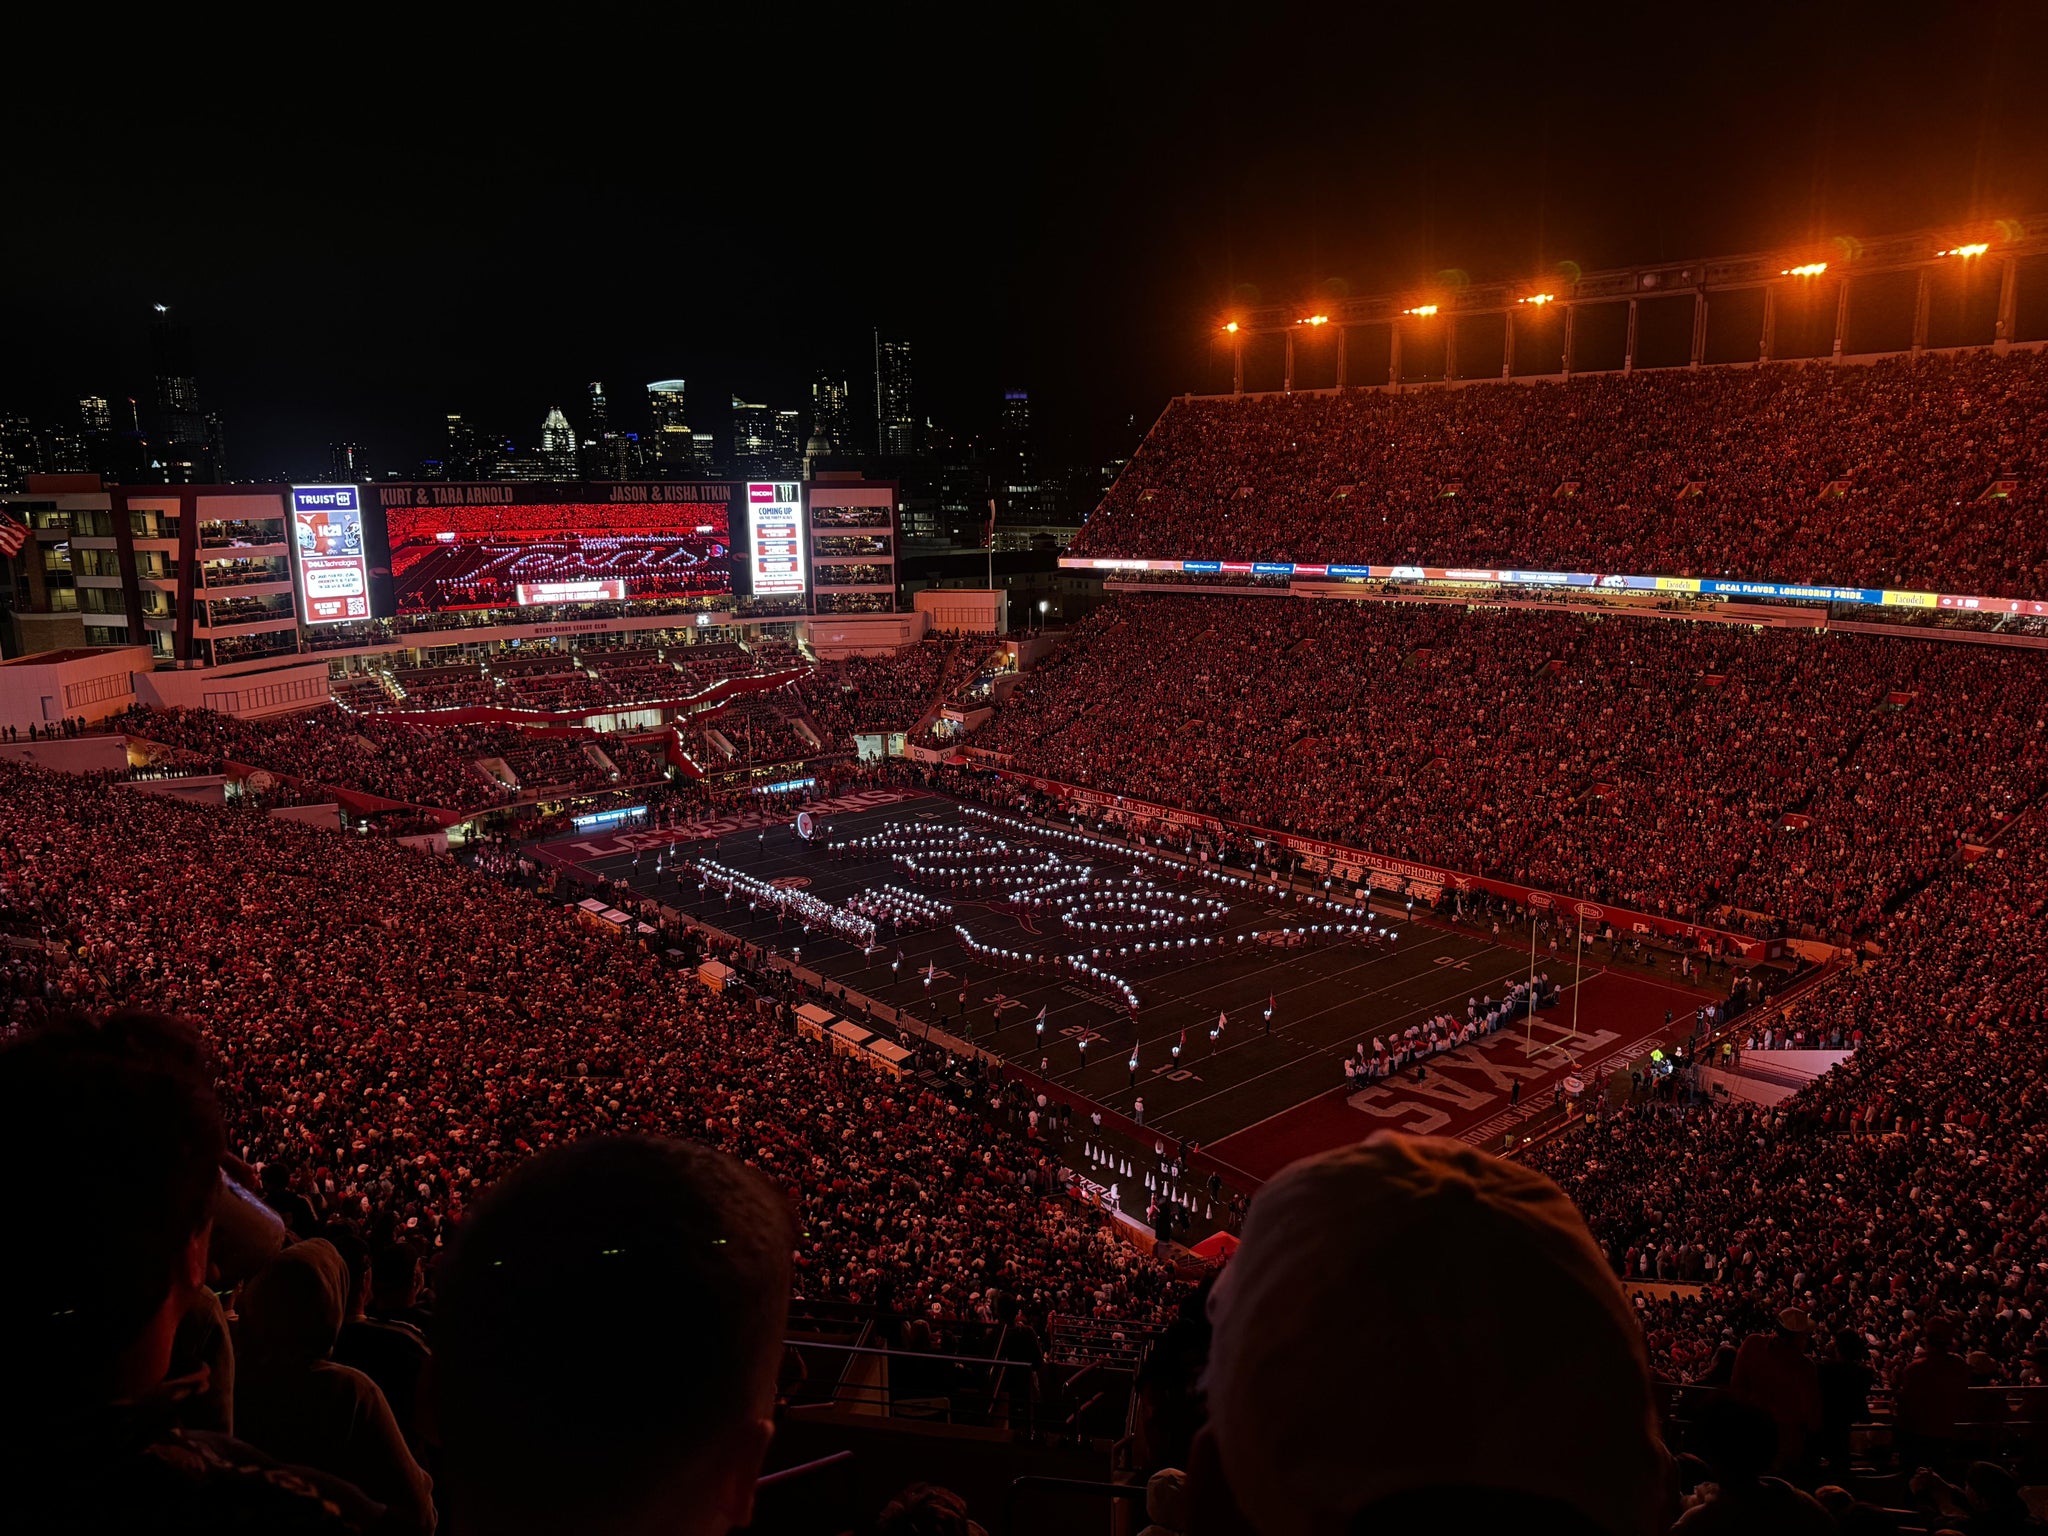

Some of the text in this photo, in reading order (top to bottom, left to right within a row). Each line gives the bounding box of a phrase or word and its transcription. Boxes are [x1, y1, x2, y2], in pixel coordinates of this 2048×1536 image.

[299, 495, 336, 504] TRUIST
[380, 487, 513, 505] KURT & TARA ARNOLD
[610, 485, 731, 501] JASON & KISHA ITKIN
[758, 507, 793, 515] COMING UP
[1665, 580, 1691, 589] Tacodeli
[1715, 583, 1865, 600] LOCAL FLAVOR. LONGHORNS PRIDE.
[1893, 593, 1925, 605] Tacodeli
[1113, 798, 1161, 817] RYAL-TEXAS
[1287, 838, 1313, 852] HOME
[1314, 844, 1328, 855] OF
[1350, 852, 1383, 867] TEXAS
[1385, 861, 1447, 883] LONGHORNS
[1058, 1024, 1102, 1043] 20
[1151, 1063, 1194, 1082] 10
[1346, 1016, 1622, 1134] TEXAS
